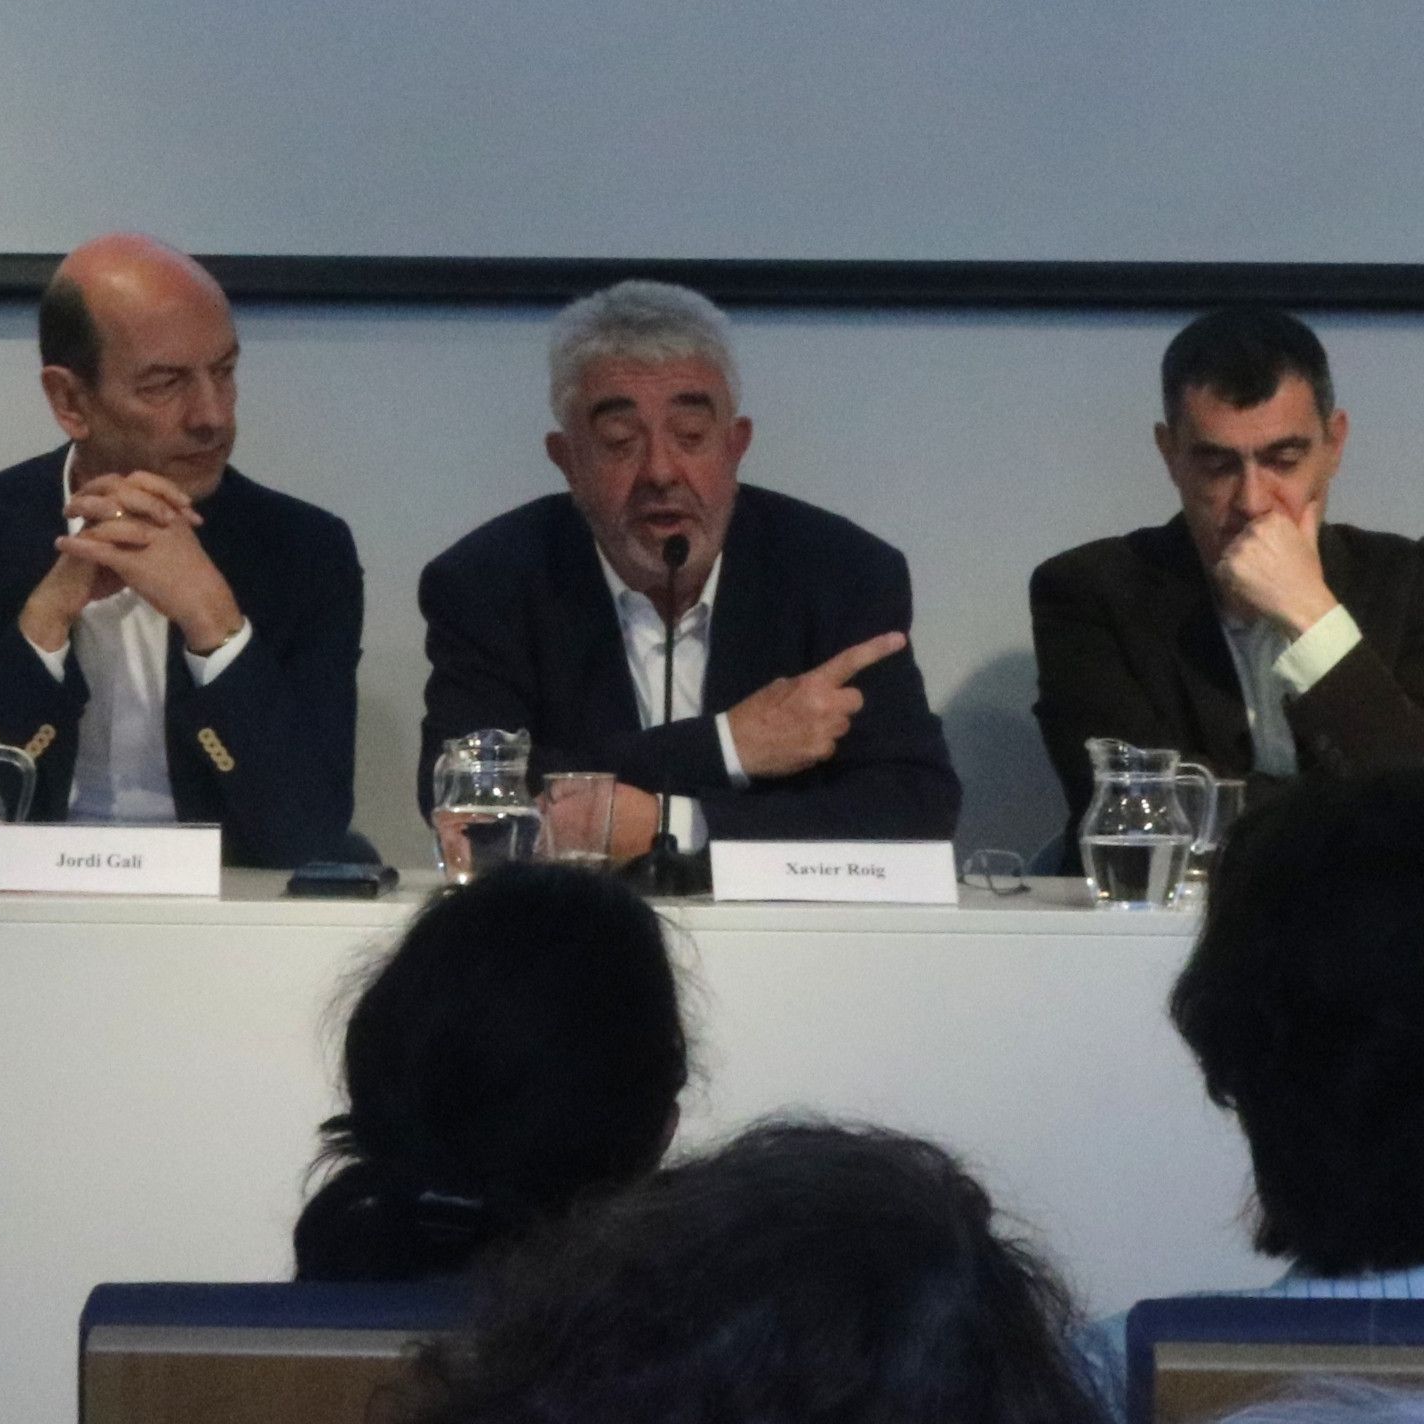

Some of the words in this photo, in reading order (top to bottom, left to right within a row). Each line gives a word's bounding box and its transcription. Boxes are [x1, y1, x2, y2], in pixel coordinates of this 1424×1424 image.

[56, 852, 102, 869] Jordi
[785, 861, 841, 877] Xavier
[847, 862, 887, 880] Roig
